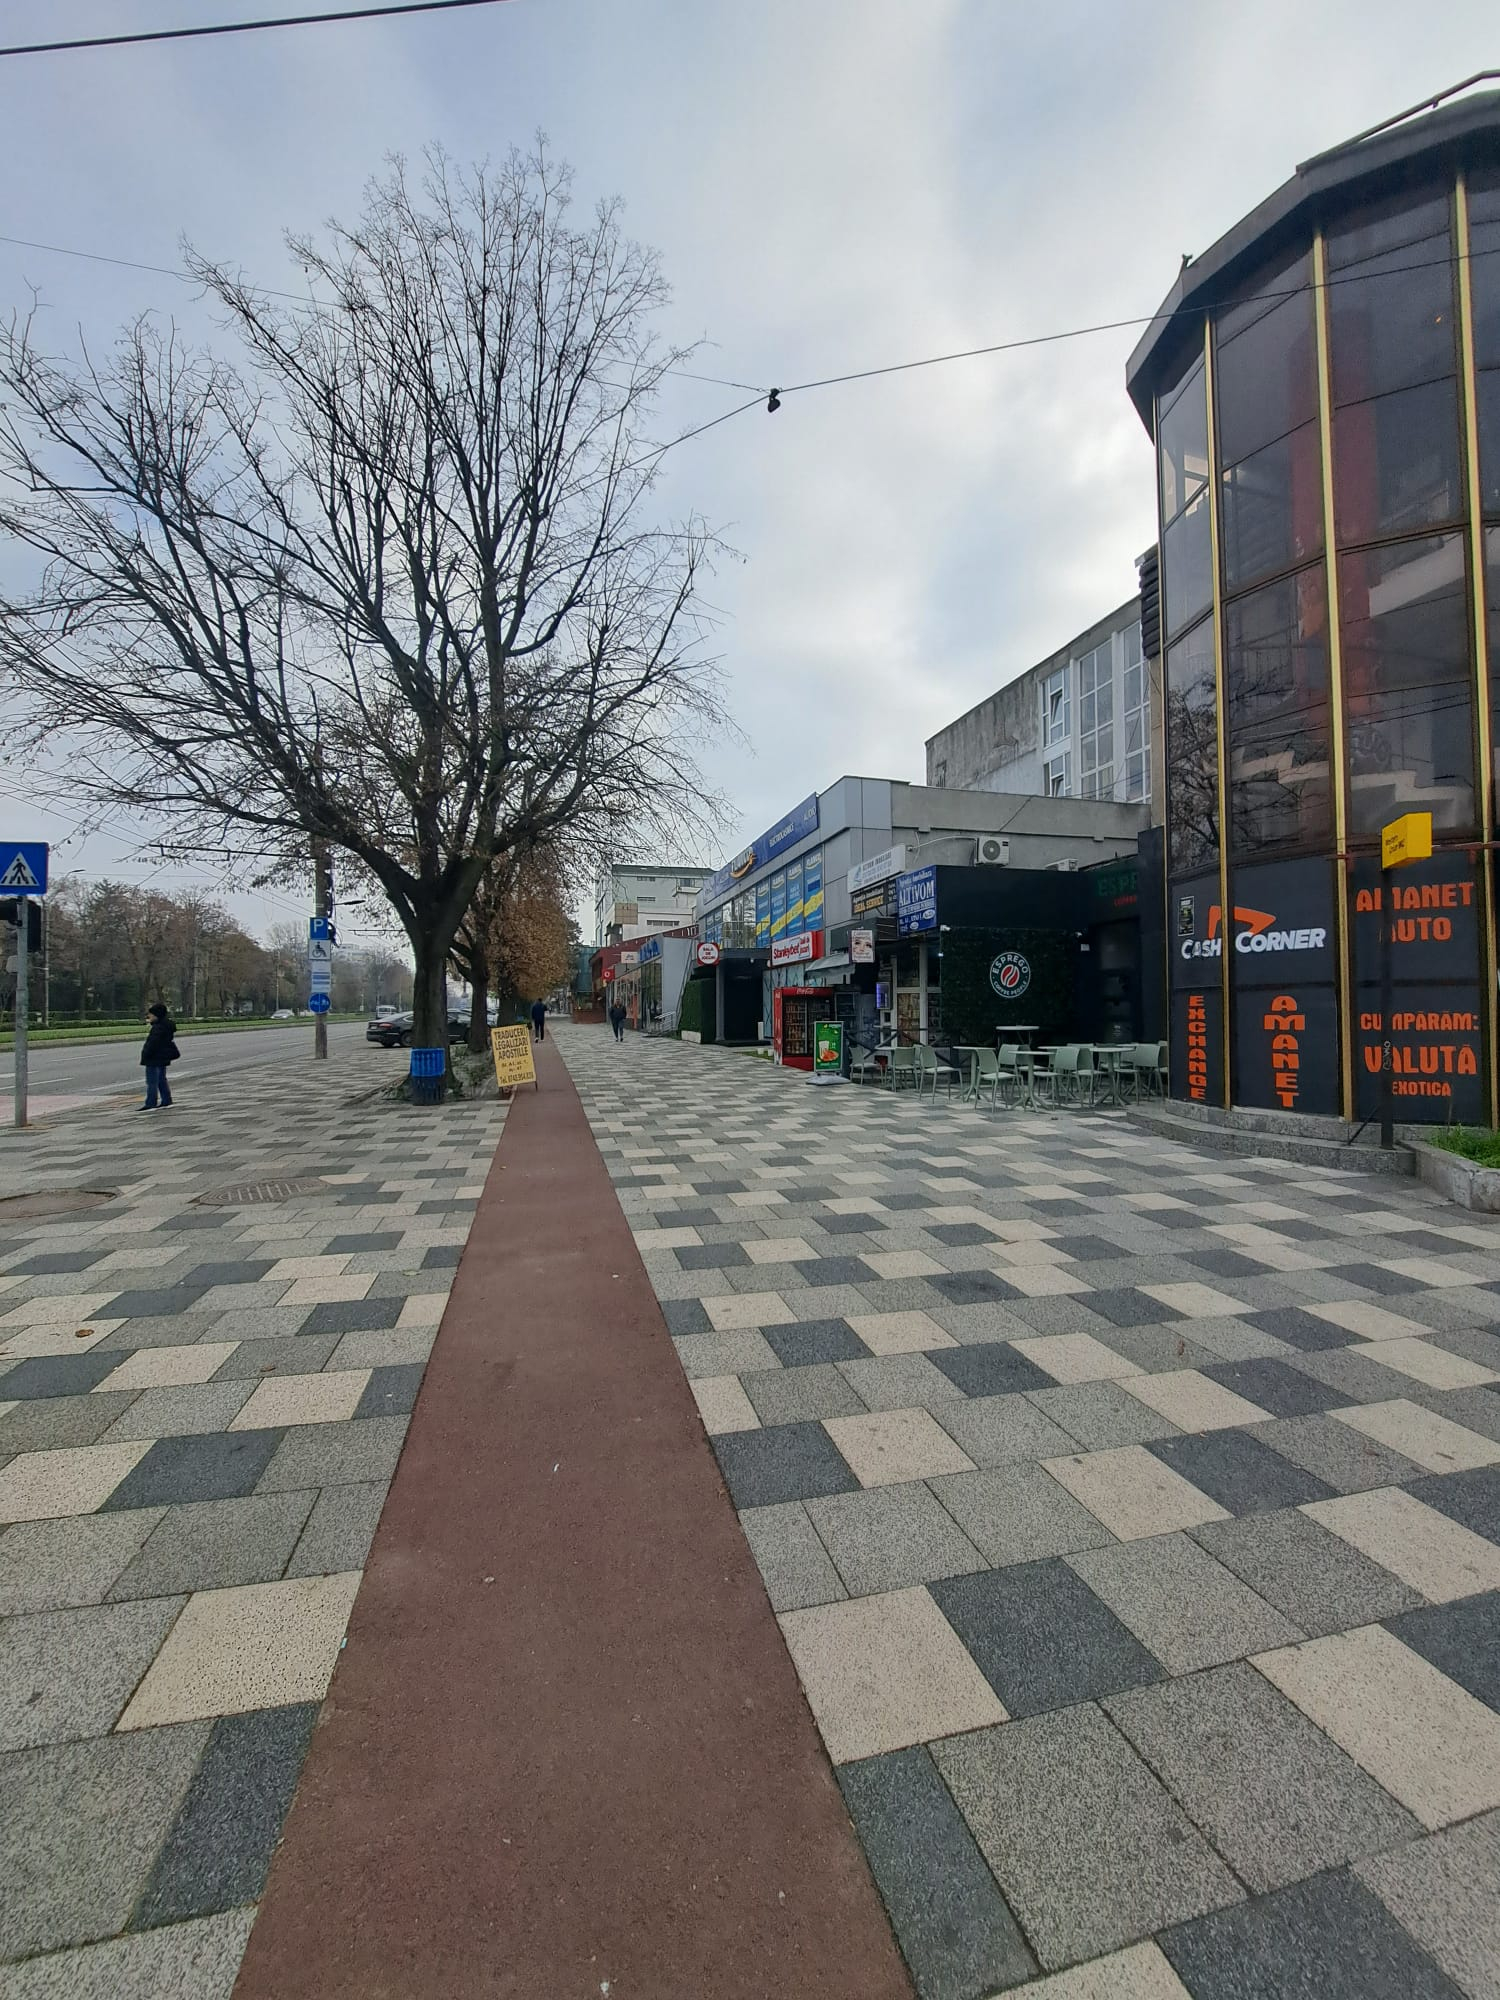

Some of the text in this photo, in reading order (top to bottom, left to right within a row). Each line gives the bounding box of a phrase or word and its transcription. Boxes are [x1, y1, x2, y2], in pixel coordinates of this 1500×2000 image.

[899, 880, 935, 907] ALTIVOM
[314, 919, 324, 932] P
[1380, 917, 1452, 942] UTO
[1181, 928, 1326, 959] CASH CORNER
[992, 954, 1029, 975] ESPREGO
[1188, 995, 1207, 1100] EXCHANGE
[1263, 995, 1305, 1107] AMANET
